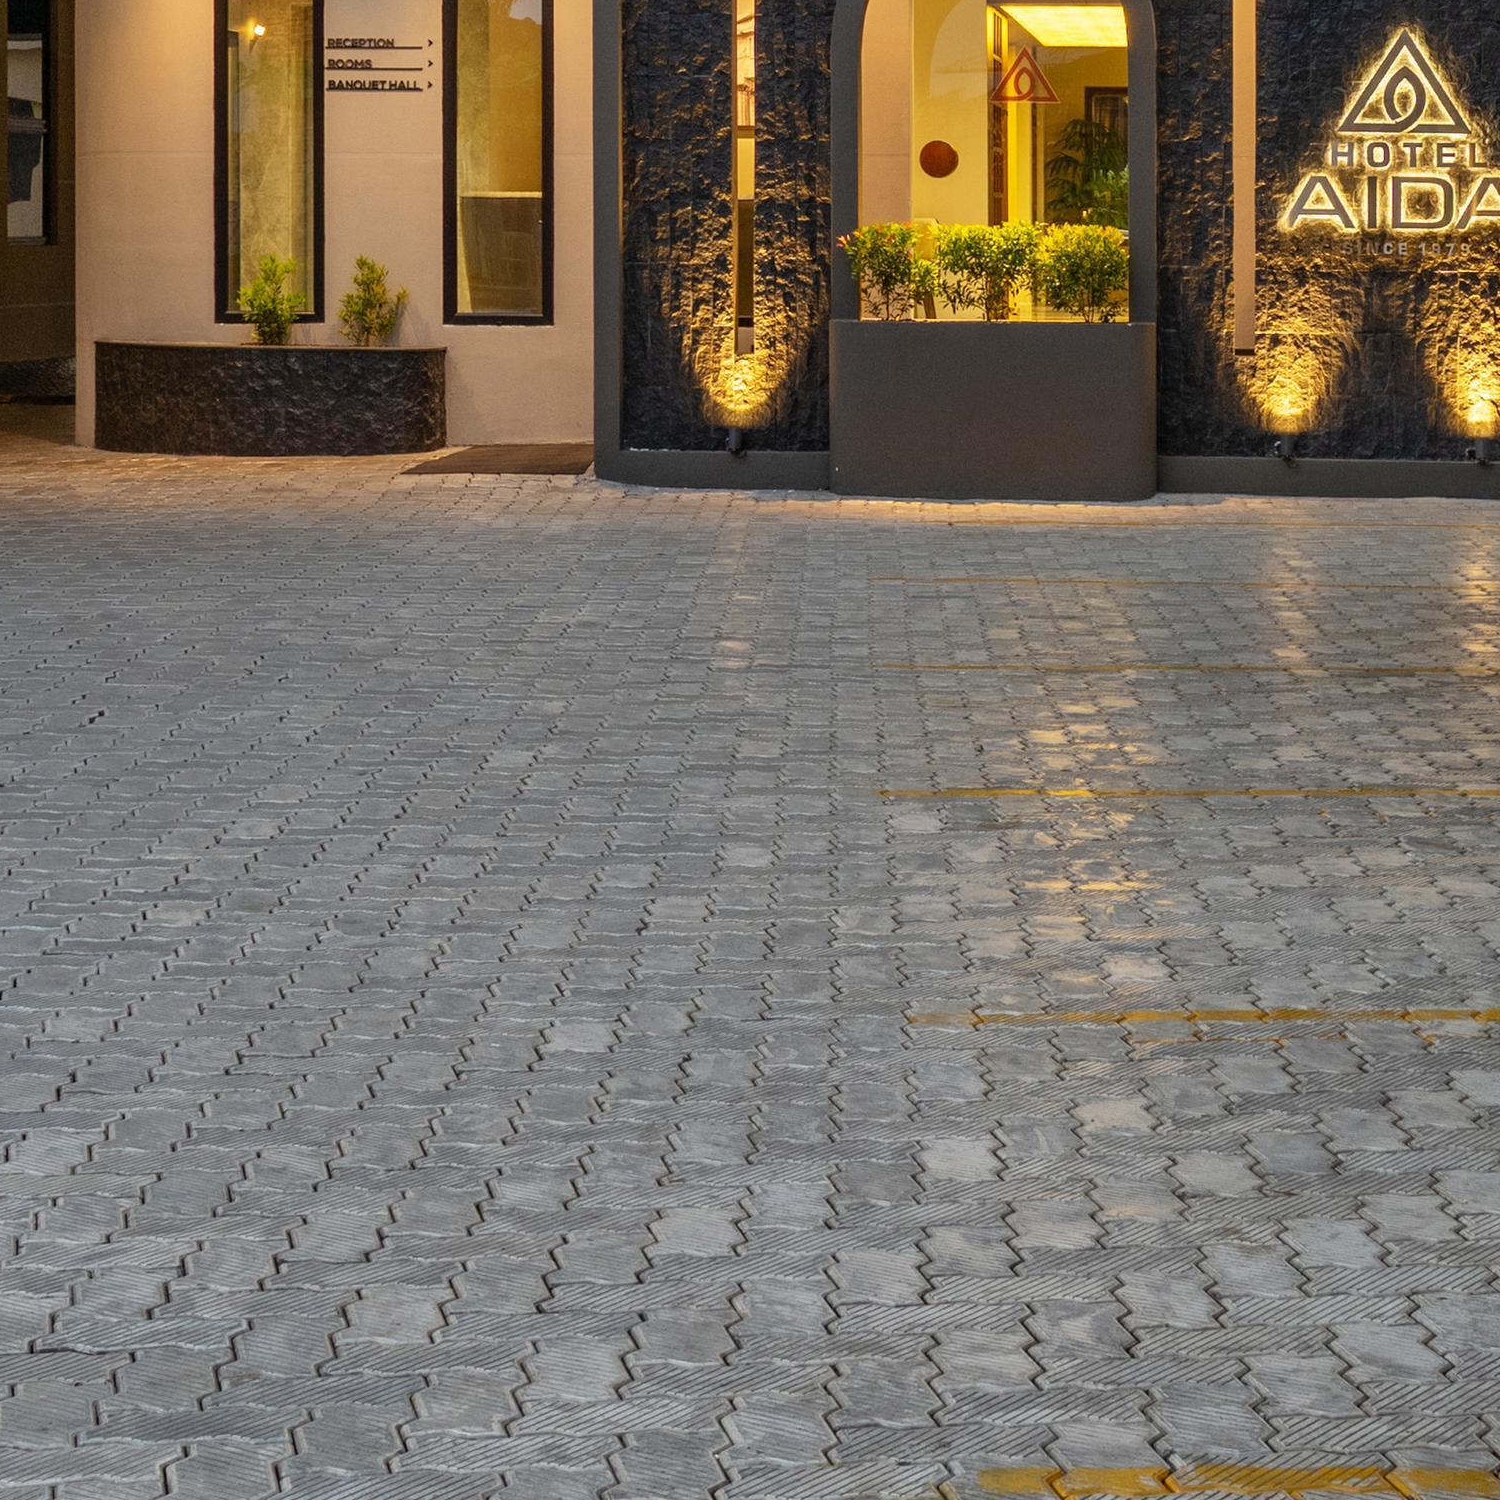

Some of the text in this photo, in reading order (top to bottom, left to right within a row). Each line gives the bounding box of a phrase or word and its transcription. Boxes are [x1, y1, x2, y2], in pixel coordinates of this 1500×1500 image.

[327, 38, 395, 48] RECEPTION
[328, 59, 373, 69] ROOMS
[328, 80, 420, 91] BANQUET HALL
[1330, 141, 1487, 168] HOTEL
[1342, 242, 1408, 256] SINCE
